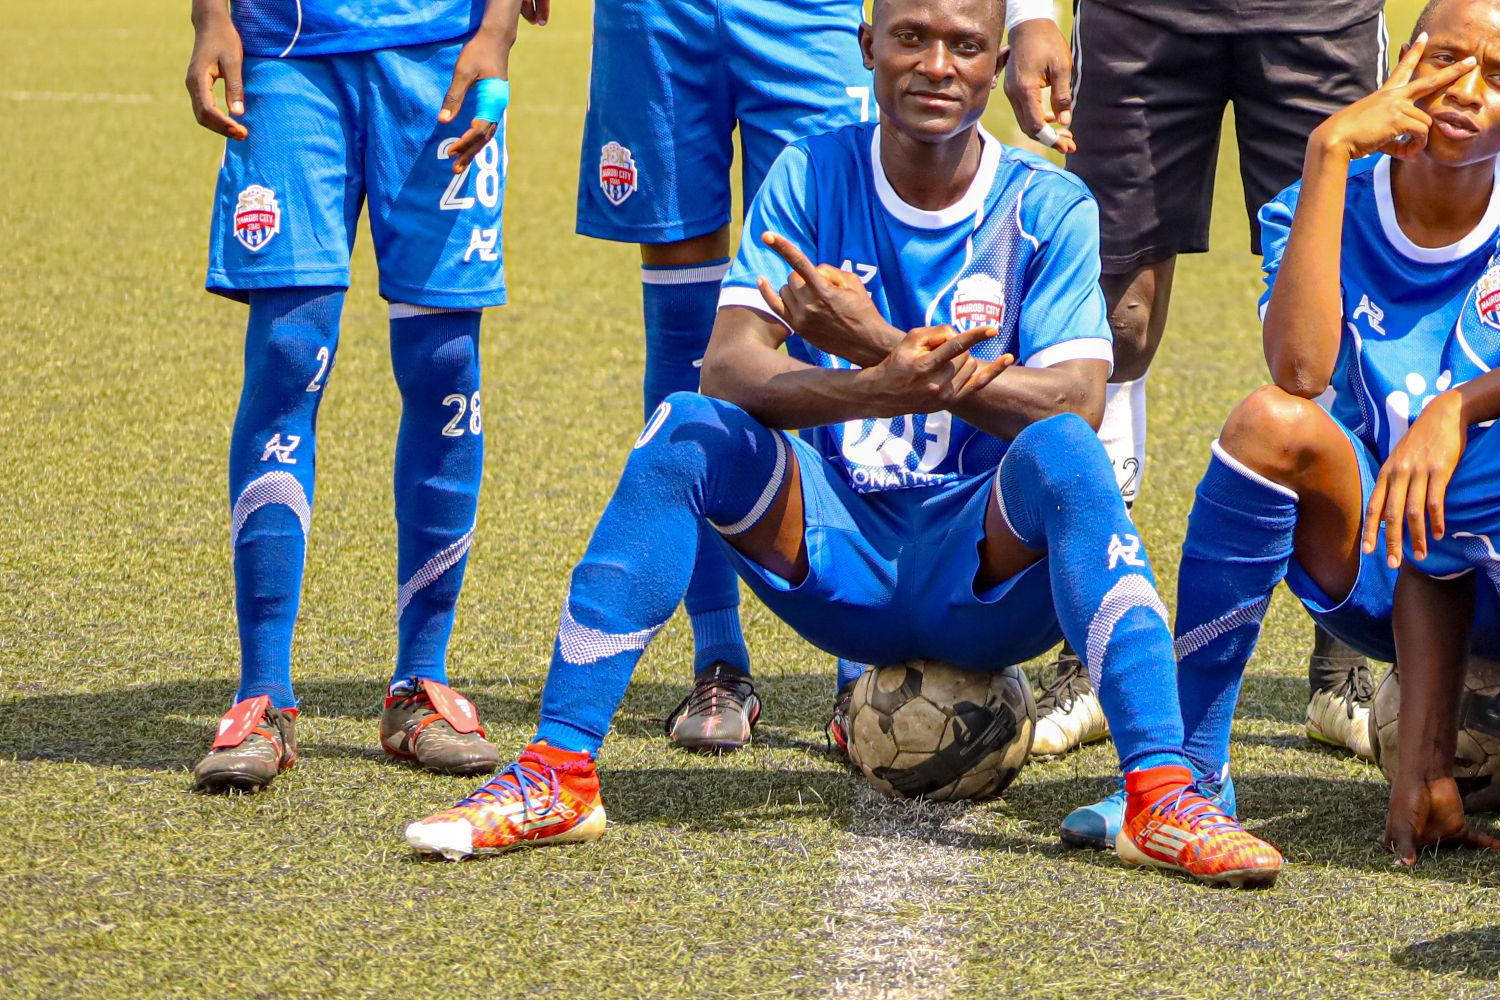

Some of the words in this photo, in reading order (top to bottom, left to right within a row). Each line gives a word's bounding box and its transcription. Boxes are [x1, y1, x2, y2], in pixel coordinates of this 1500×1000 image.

[437, 136, 499, 211] 28
[463, 228, 499, 263] AZ
[957, 303, 985, 315] NAIROBI
[985, 304, 1001, 318] CITY
[1353, 293, 1386, 336] AZ
[306, 346, 336, 392] 2
[441, 390, 482, 437] 28
[1107, 532, 1145, 569] AZ
